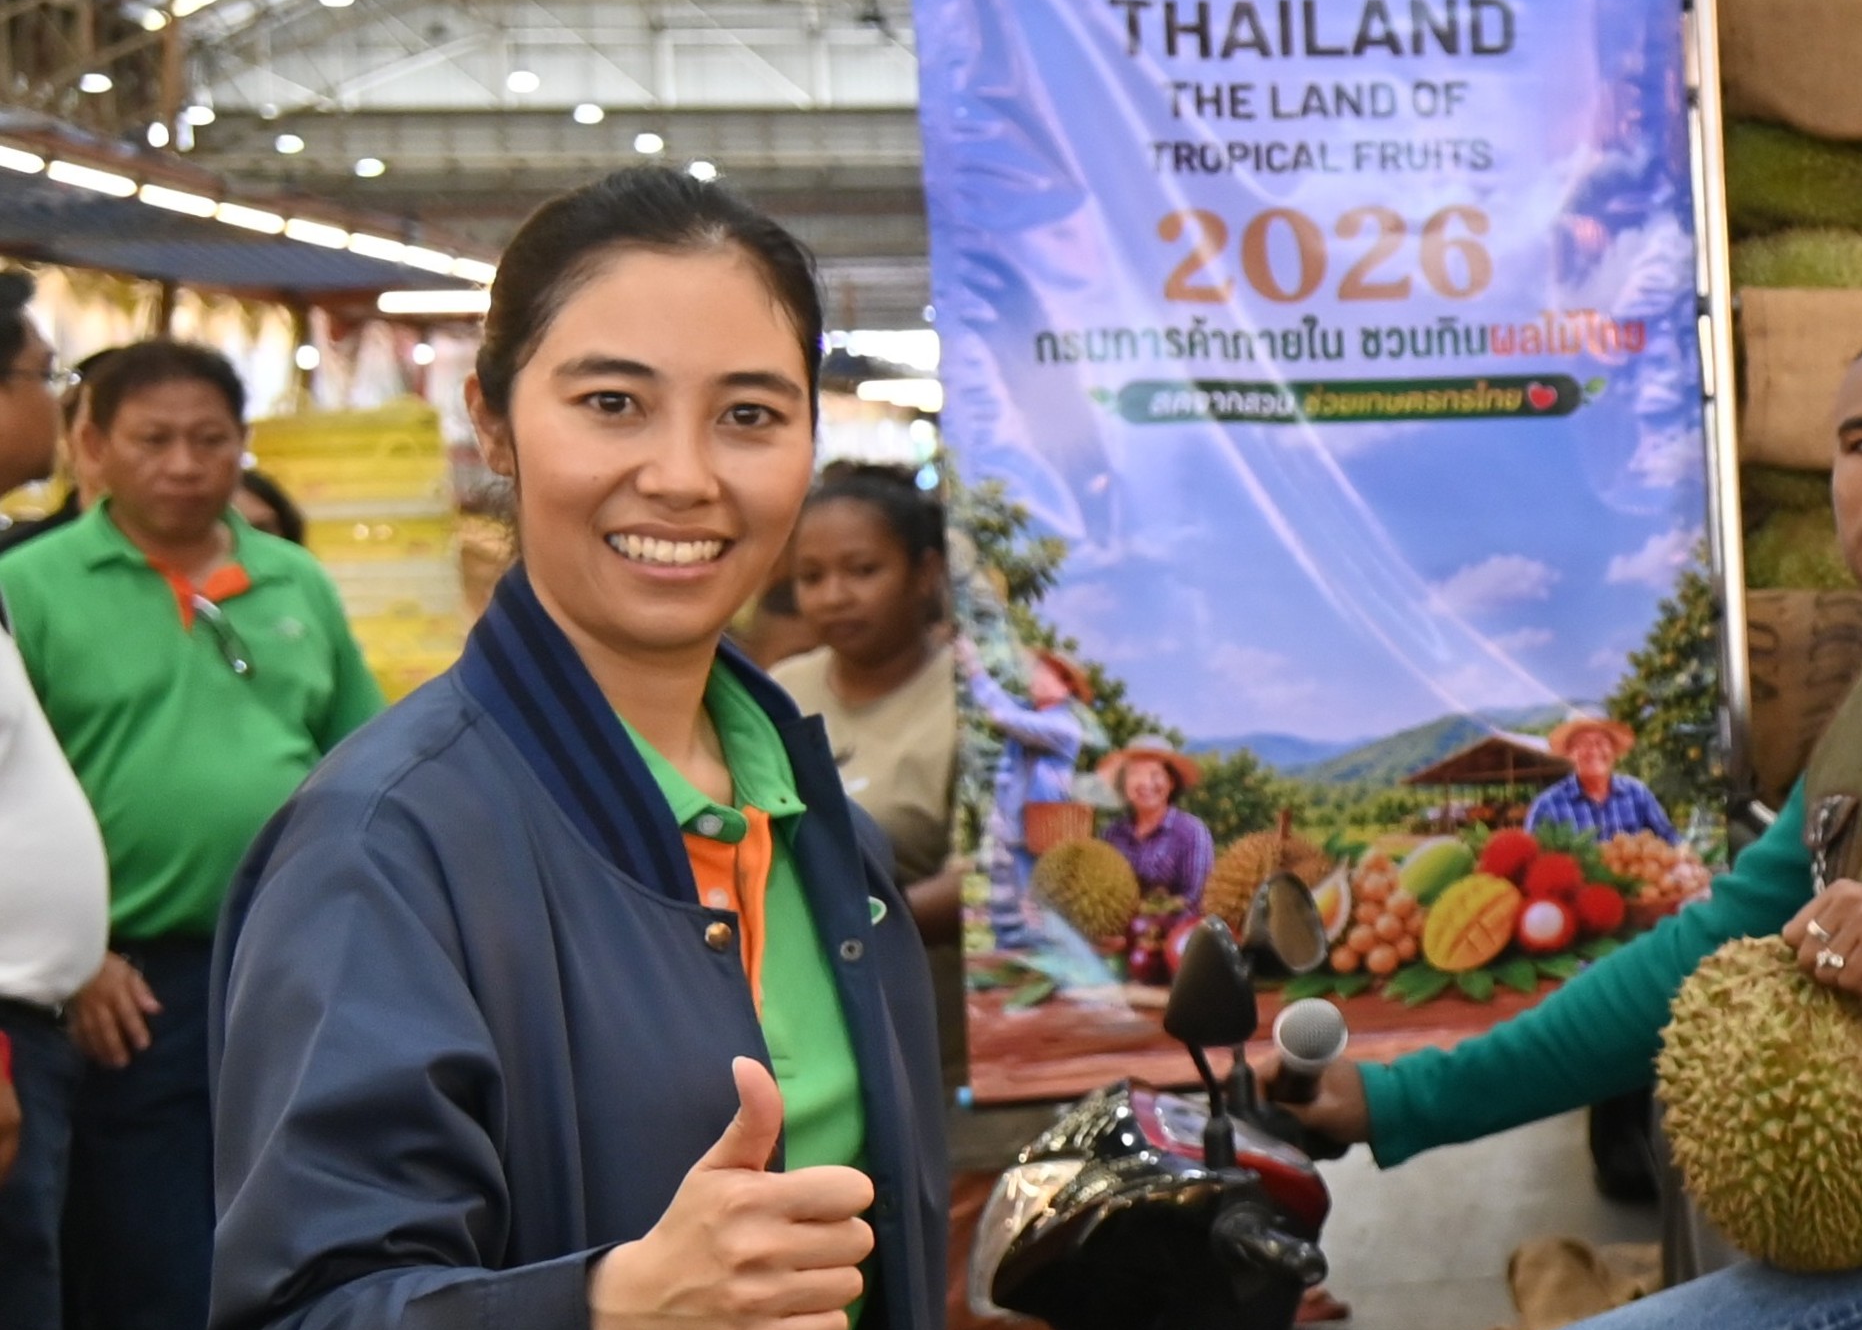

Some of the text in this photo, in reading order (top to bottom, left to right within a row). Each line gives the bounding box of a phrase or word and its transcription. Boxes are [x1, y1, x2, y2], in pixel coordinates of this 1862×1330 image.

[1170, 79, 1469, 120] THE LAND OF
[1154, 138, 1493, 175] TROPICAL FRUITS
[1156, 204, 1494, 304] 2026
[1035, 315, 1344, 364] กรมการค้าภายใน
